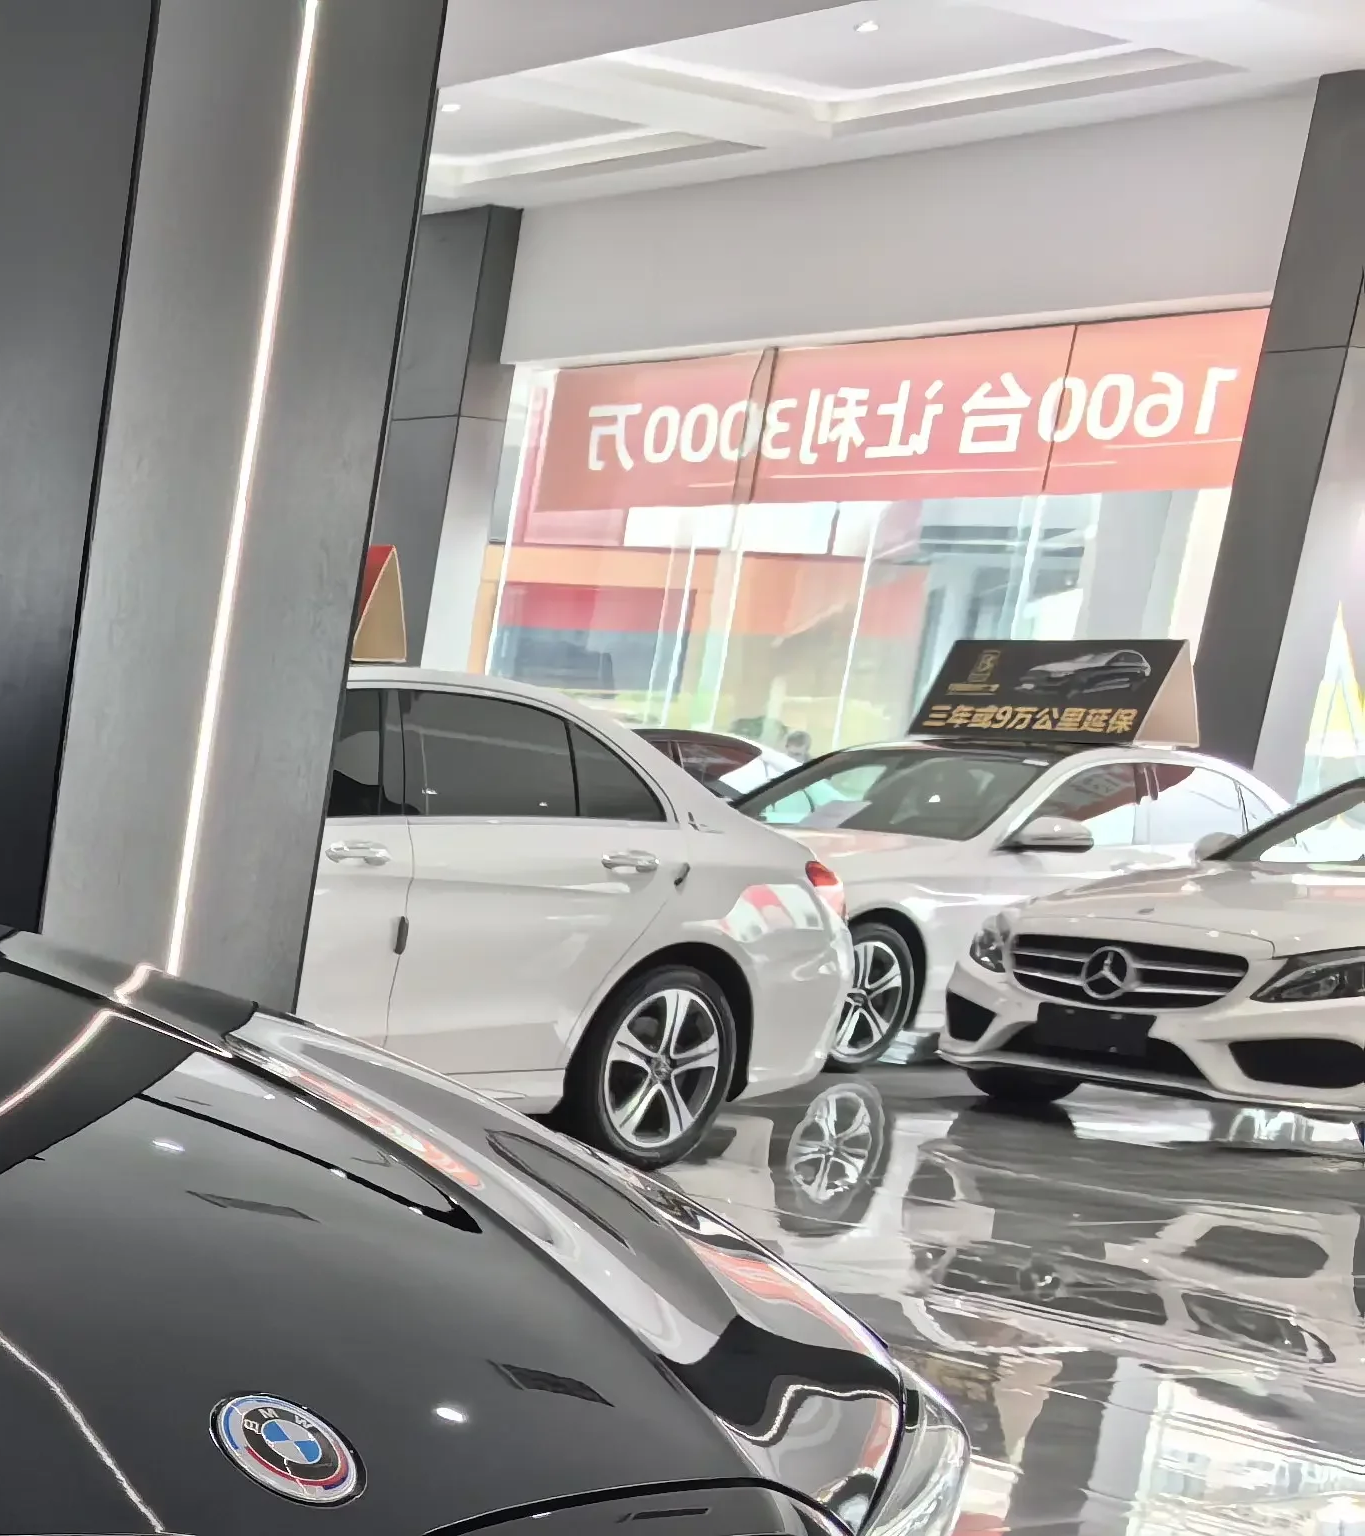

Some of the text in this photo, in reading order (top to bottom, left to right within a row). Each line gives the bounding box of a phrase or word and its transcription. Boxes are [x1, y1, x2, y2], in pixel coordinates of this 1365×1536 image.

[922, 703, 1139, 735] 三年或9万公里延保
[243, 1406, 316, 1436] BMW
